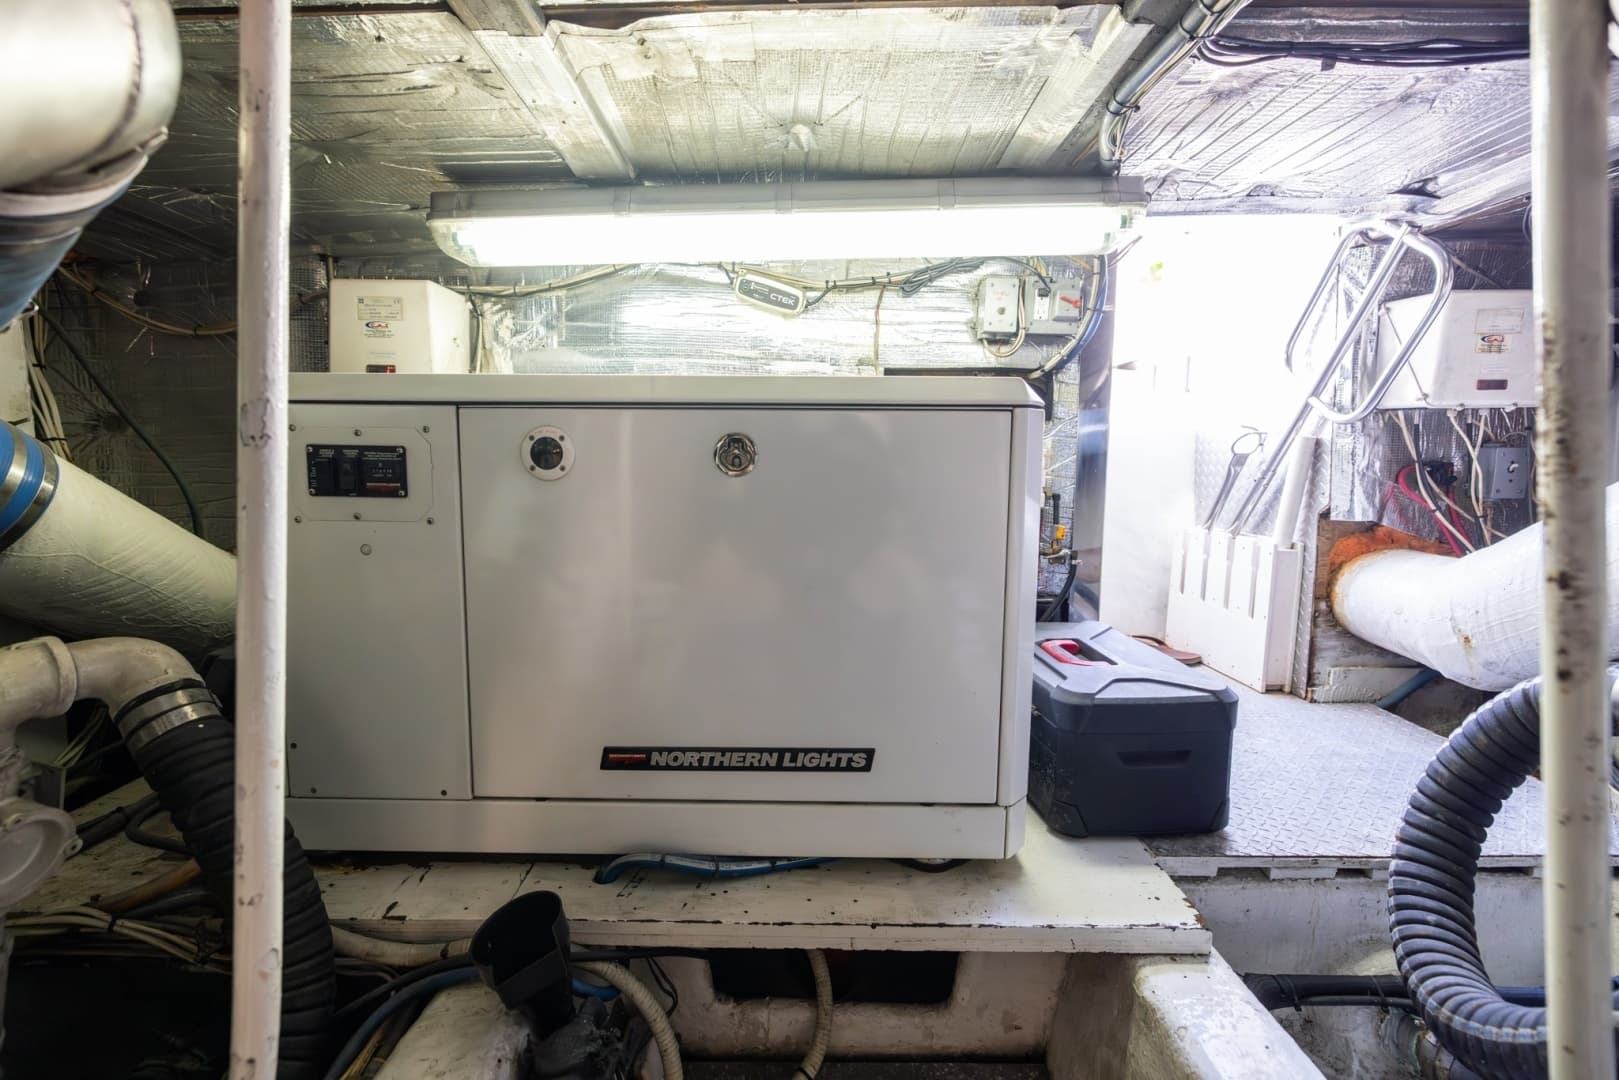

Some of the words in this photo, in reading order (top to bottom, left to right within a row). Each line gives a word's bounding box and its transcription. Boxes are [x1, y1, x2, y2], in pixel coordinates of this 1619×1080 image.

[769, 293, 796, 306] CTEK
[650, 751, 778, 767] NORTHERN
[782, 752, 868, 768] LIGHTS
